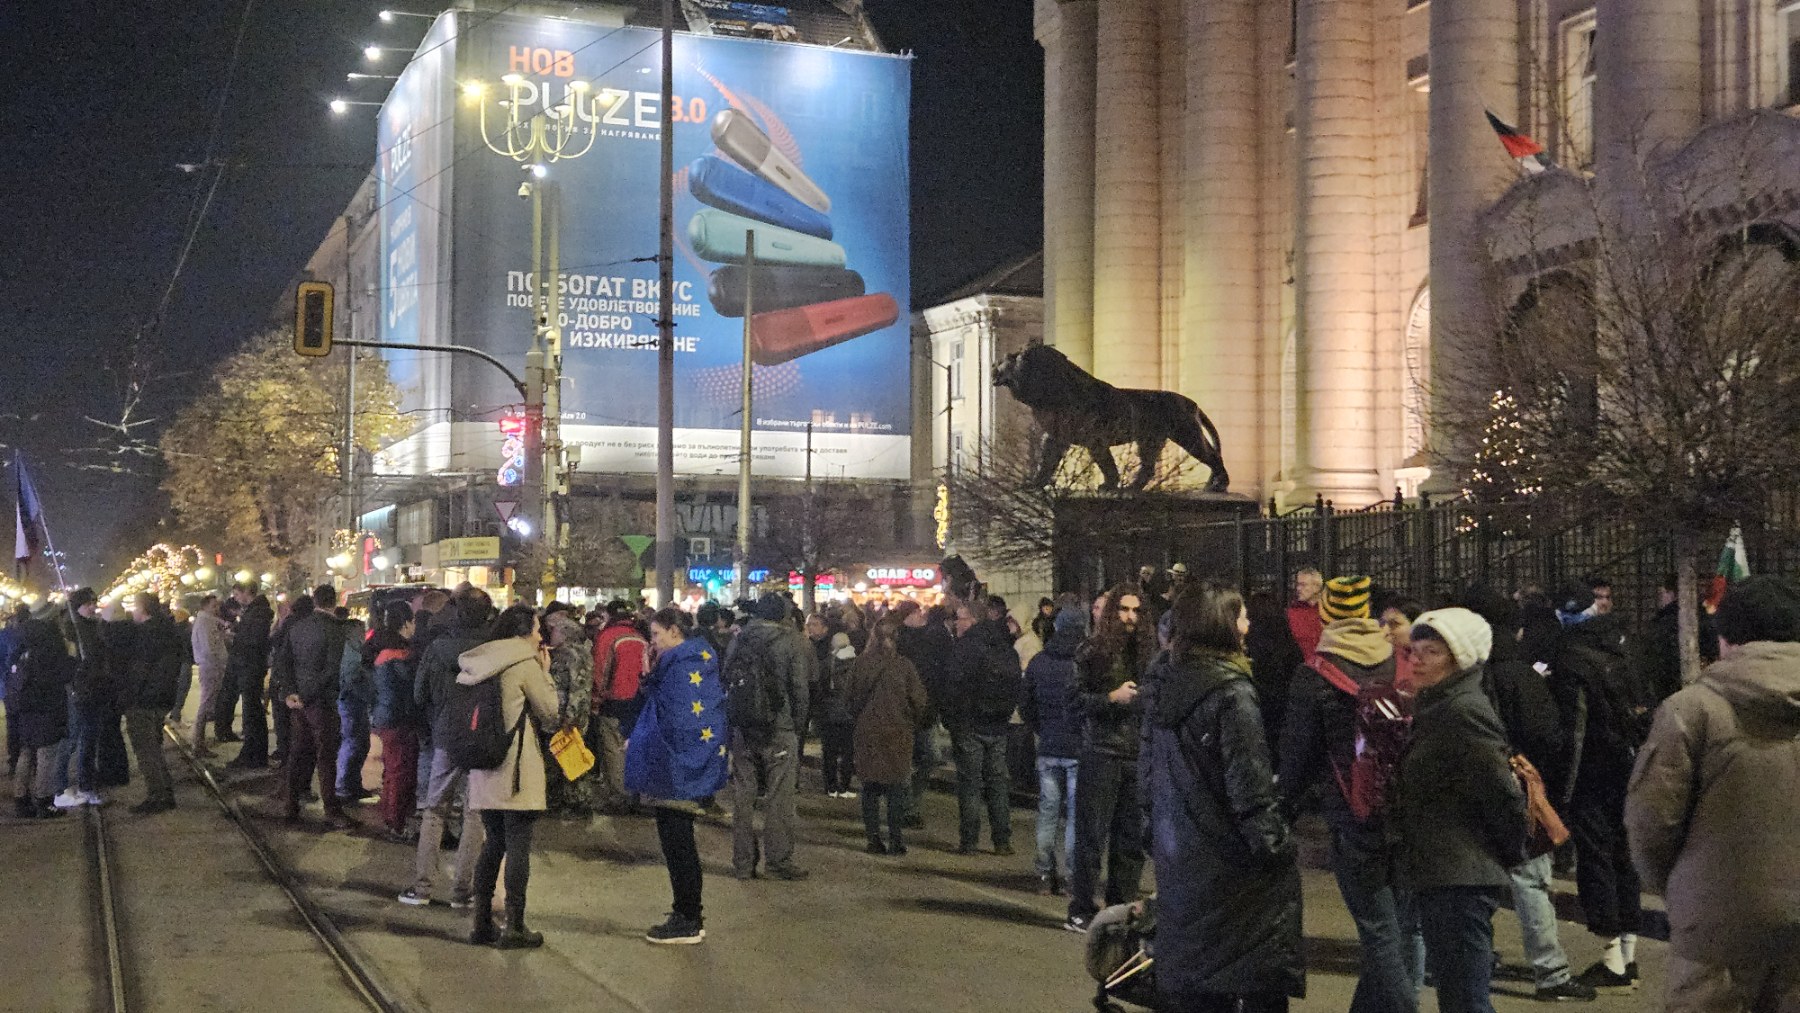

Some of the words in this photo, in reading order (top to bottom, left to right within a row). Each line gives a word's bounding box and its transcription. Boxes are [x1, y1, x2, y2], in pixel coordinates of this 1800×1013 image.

[509, 45, 574, 78] НОВ
[510, 79, 661, 129] PULZE
[671, 95, 707, 123] 3.0
[547, 312, 632, 330] О-ДОБРО
[575, 412, 586, 420] 2.0
[867, 568, 907, 580] GRAB
[911, 568, 935, 580] GO
